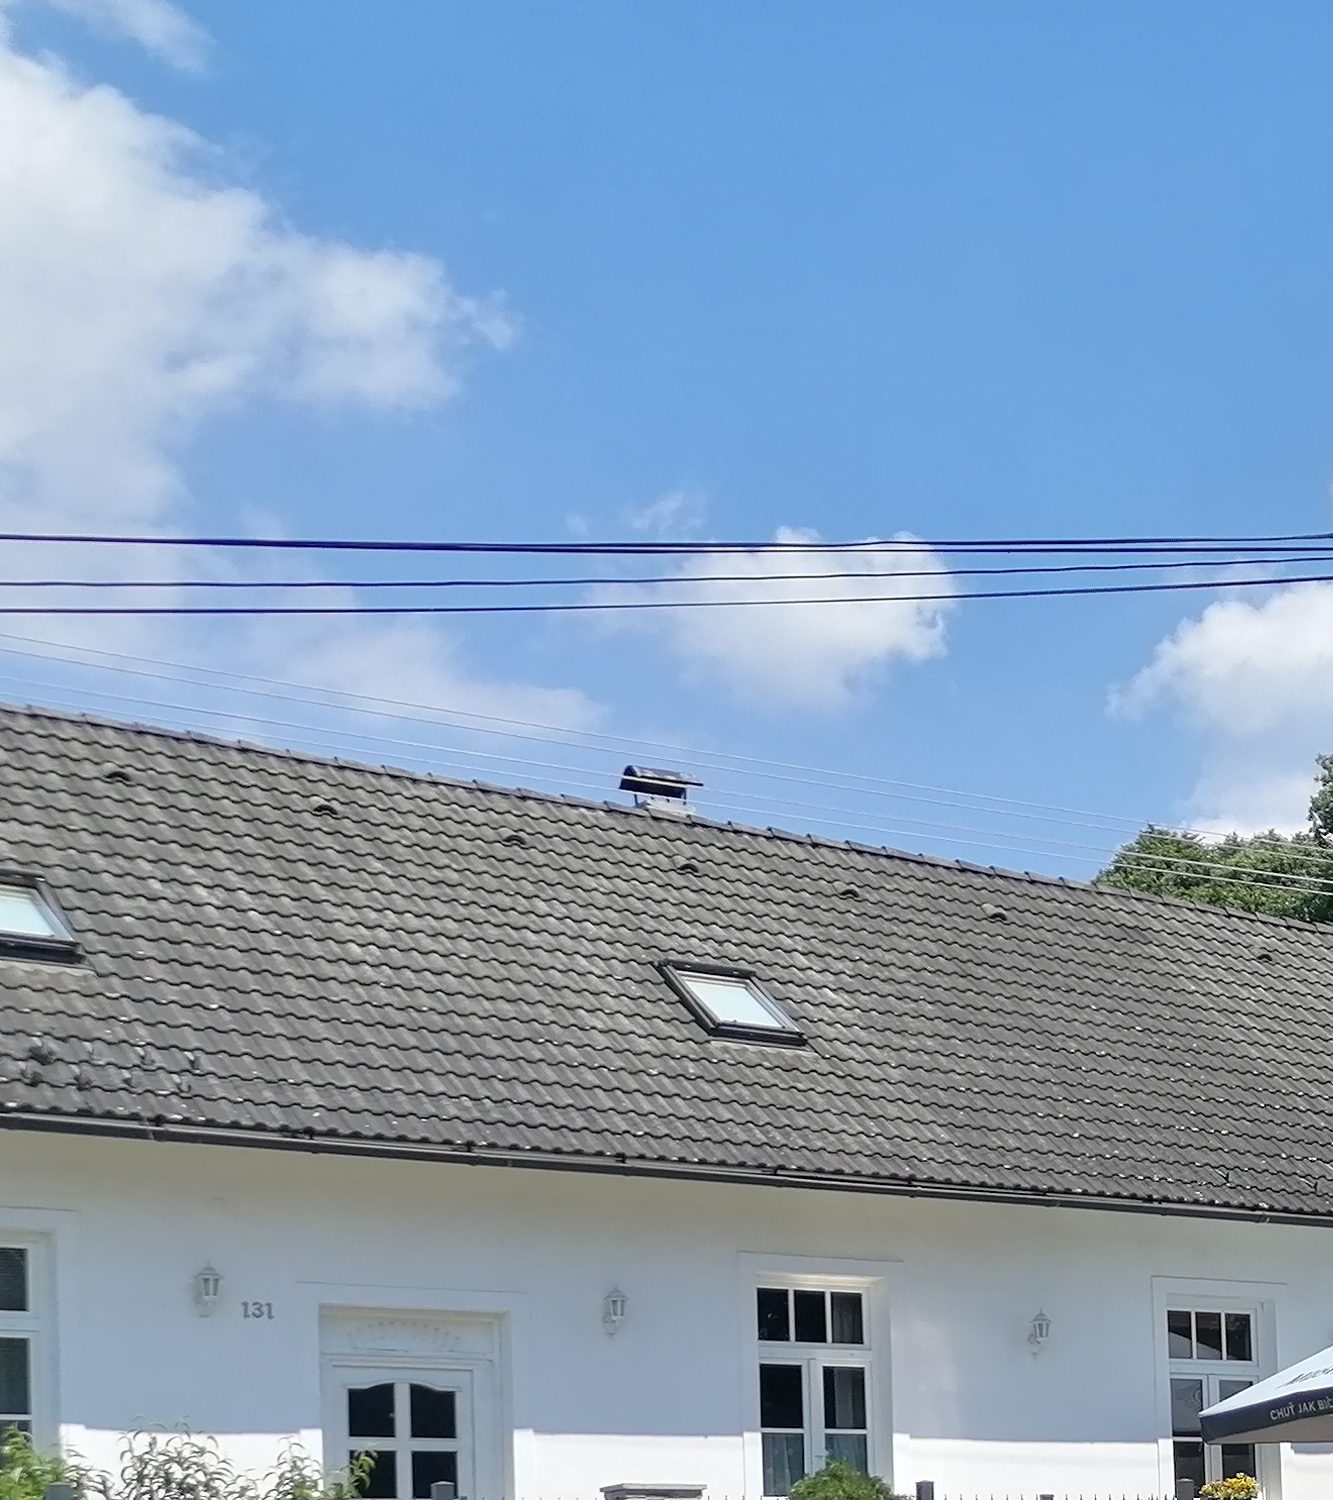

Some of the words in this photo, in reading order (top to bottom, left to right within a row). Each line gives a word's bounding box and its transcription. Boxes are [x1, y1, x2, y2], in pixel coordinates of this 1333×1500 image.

[241, 1301, 274, 1320] 131
[1269, 1402, 1296, 1420] CHUŤ
[1298, 1401, 1317, 1413] JAK
